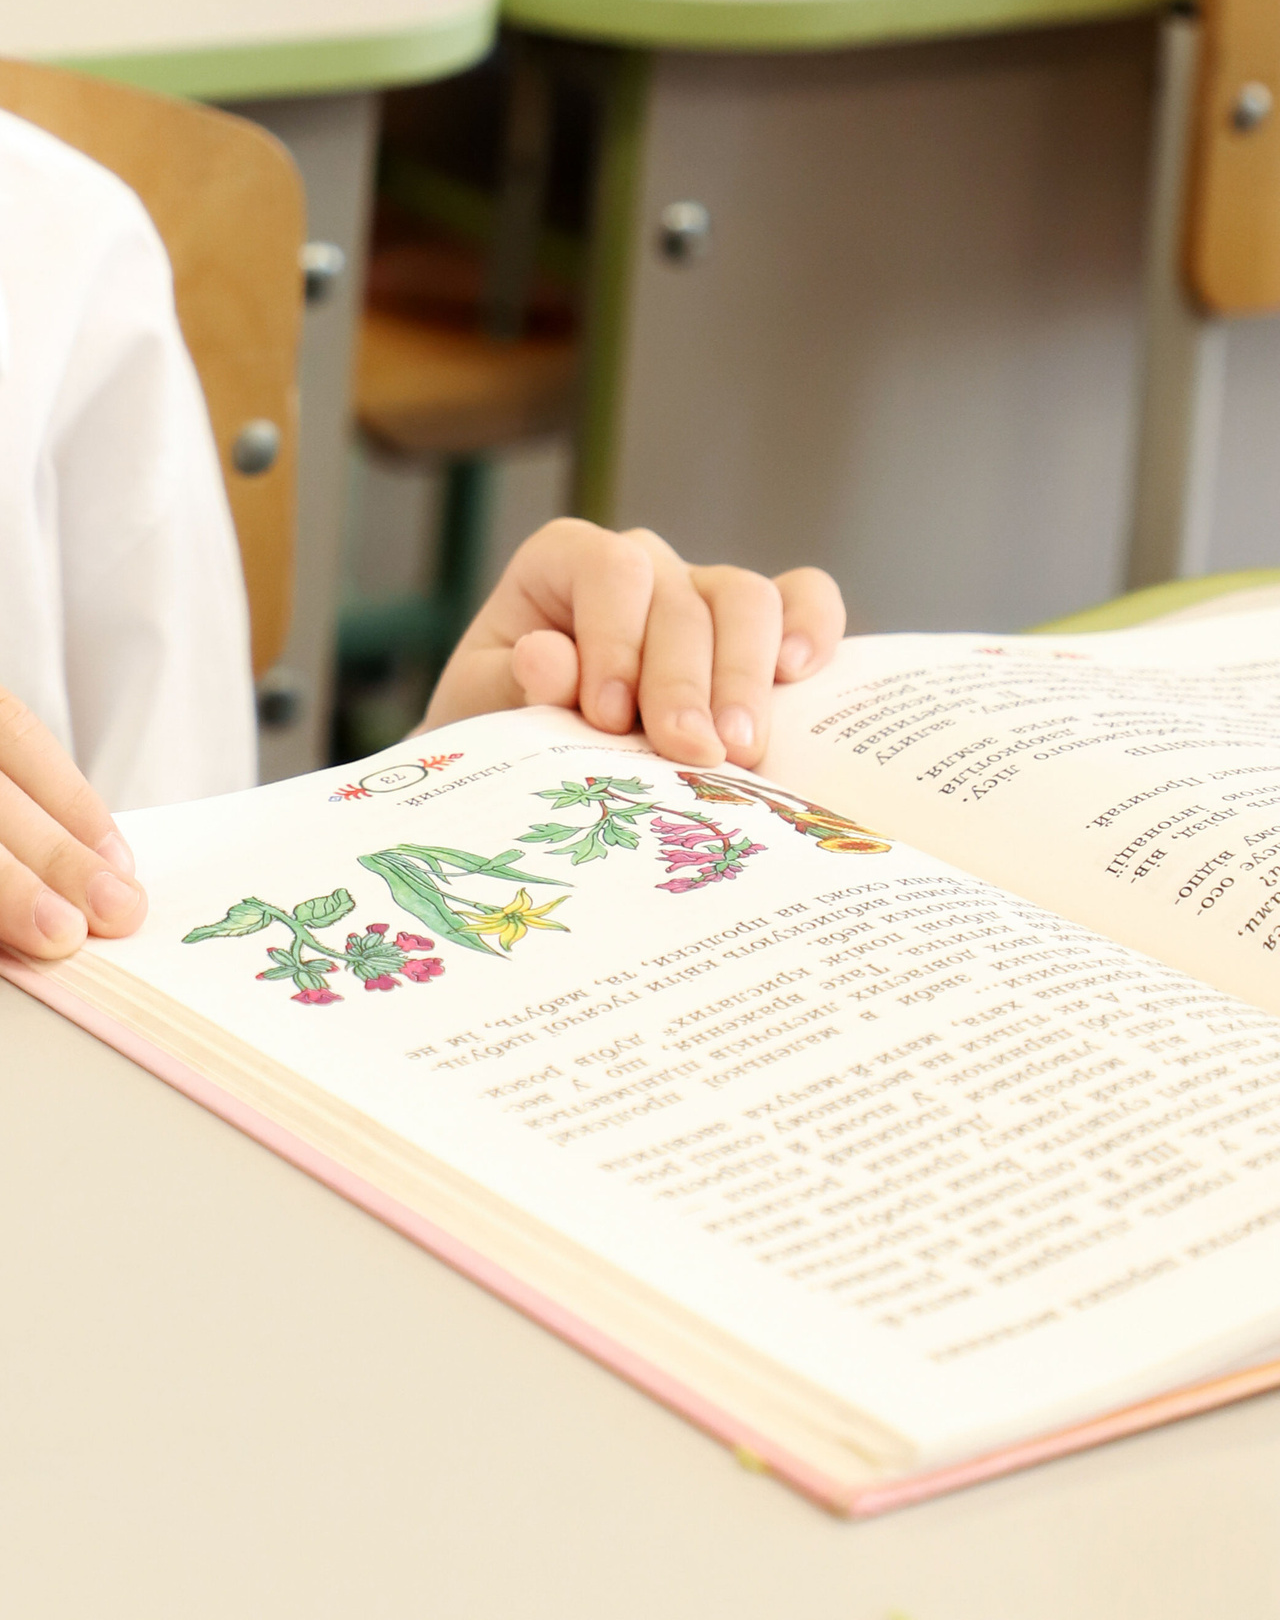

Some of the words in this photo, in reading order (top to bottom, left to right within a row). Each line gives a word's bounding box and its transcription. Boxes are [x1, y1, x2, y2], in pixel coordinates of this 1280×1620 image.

[833, 693, 937, 744] яскрави-
[851, 697, 978, 755] перетинав
[873, 718, 957, 767] залиту
[914, 736, 998, 781] земля,
[379, 770, 407, 785] 73
[936, 727, 1075, 796] дзюркотіла
[395, 760, 514, 807] гіллястий.
[961, 763, 1021, 802] лісу.
[1083, 776, 1206, 829] Прочитай.
[1103, 803, 1210, 878] інтонації
[1170, 807, 1239, 839] дрізд,
[893, 875, 964, 890] Вони
[1129, 847, 1168, 884] вів-
[1173, 849, 1236, 905] відпо-
[773, 901, 809, 919] на
[812, 880, 891, 907] схожі
[878, 898, 998, 925] скалочки
[893, 884, 1006, 903] Скромно
[1195, 876, 1235, 916] осо-
[720, 896, 890, 960] виблискують
[805, 920, 875, 947] неба.
[896, 923, 1014, 957] китичка.
[911, 909, 1001, 934] діброві
[639, 915, 771, 968] проліски,
[818, 930, 905, 968] поміж
[983, 933, 1043, 954] двох
[987, 945, 1091, 972] скільки
[592, 969, 639, 987] та,
[643, 957, 719, 993] квіти
[817, 961, 891, 991] Таке
[846, 947, 977, 1002] довгастих
[895, 972, 973, 1007] зваби
[1031, 968, 1145, 1000] крижана
[482, 987, 590, 1030] мабуть,
[540, 989, 642, 1035] гусячої
[660, 991, 806, 1052] враження,
[857, 1008, 880, 1022] в
[949, 998, 1024, 1028] хата,
[1052, 998, 1091, 1014] як
[1076, 1007, 1131, 1031] тобі
[443, 1029, 481, 1048] їм
[707, 1000, 840, 1061] листочків
[959, 1012, 1051, 1054] тільки
[403, 1043, 439, 1061] не
[433, 1030, 537, 1074] цибуль-
[572, 1031, 645, 1068] дубів
[603, 1056, 649, 1079] що
[701, 1024, 841, 1089] маленької
[918, 1050, 956, 1070] на
[935, 1026, 1074, 1086] парничок.
[522, 1059, 702, 1129] піднімається
[570, 1076, 591, 1092] у
[771, 1068, 915, 1132] весняному
